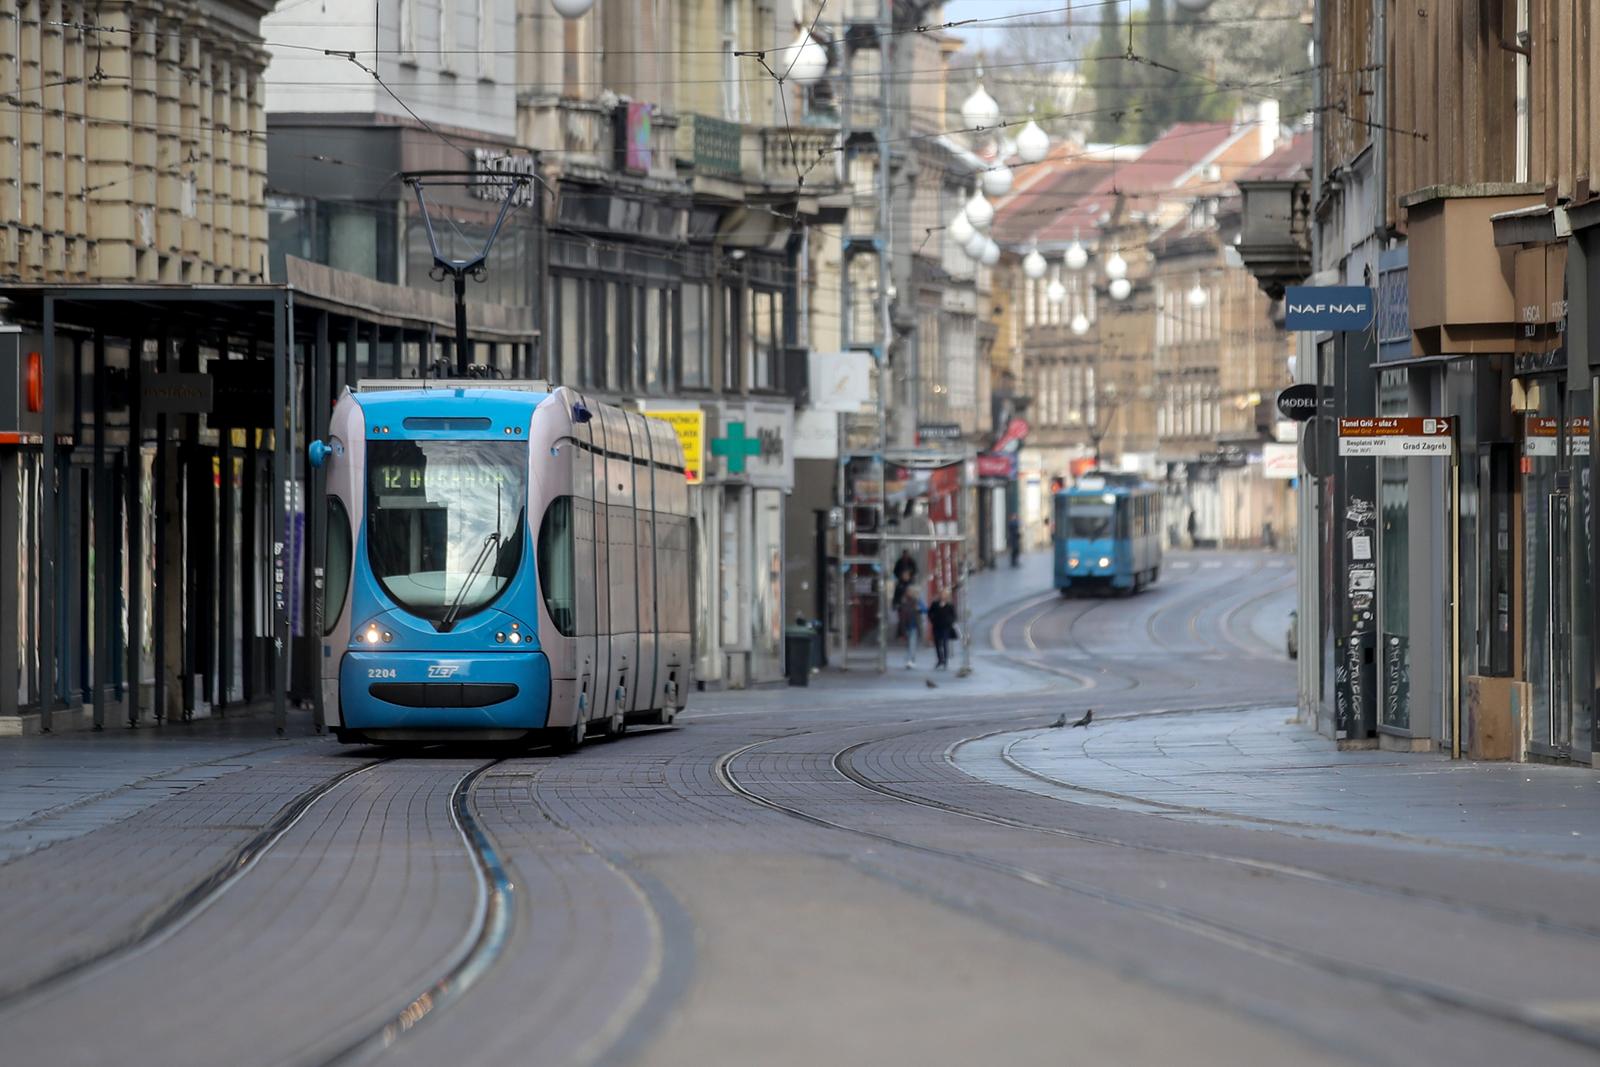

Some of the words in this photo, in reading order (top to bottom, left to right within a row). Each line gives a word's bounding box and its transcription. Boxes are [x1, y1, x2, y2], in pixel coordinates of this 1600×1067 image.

[1289, 304, 1326, 313] NAF
[1329, 304, 1366, 313] NAF
[1422, 443, 1447, 451] Zagreb
[382, 465, 401, 488] 12
[368, 669, 396, 678] 2204
